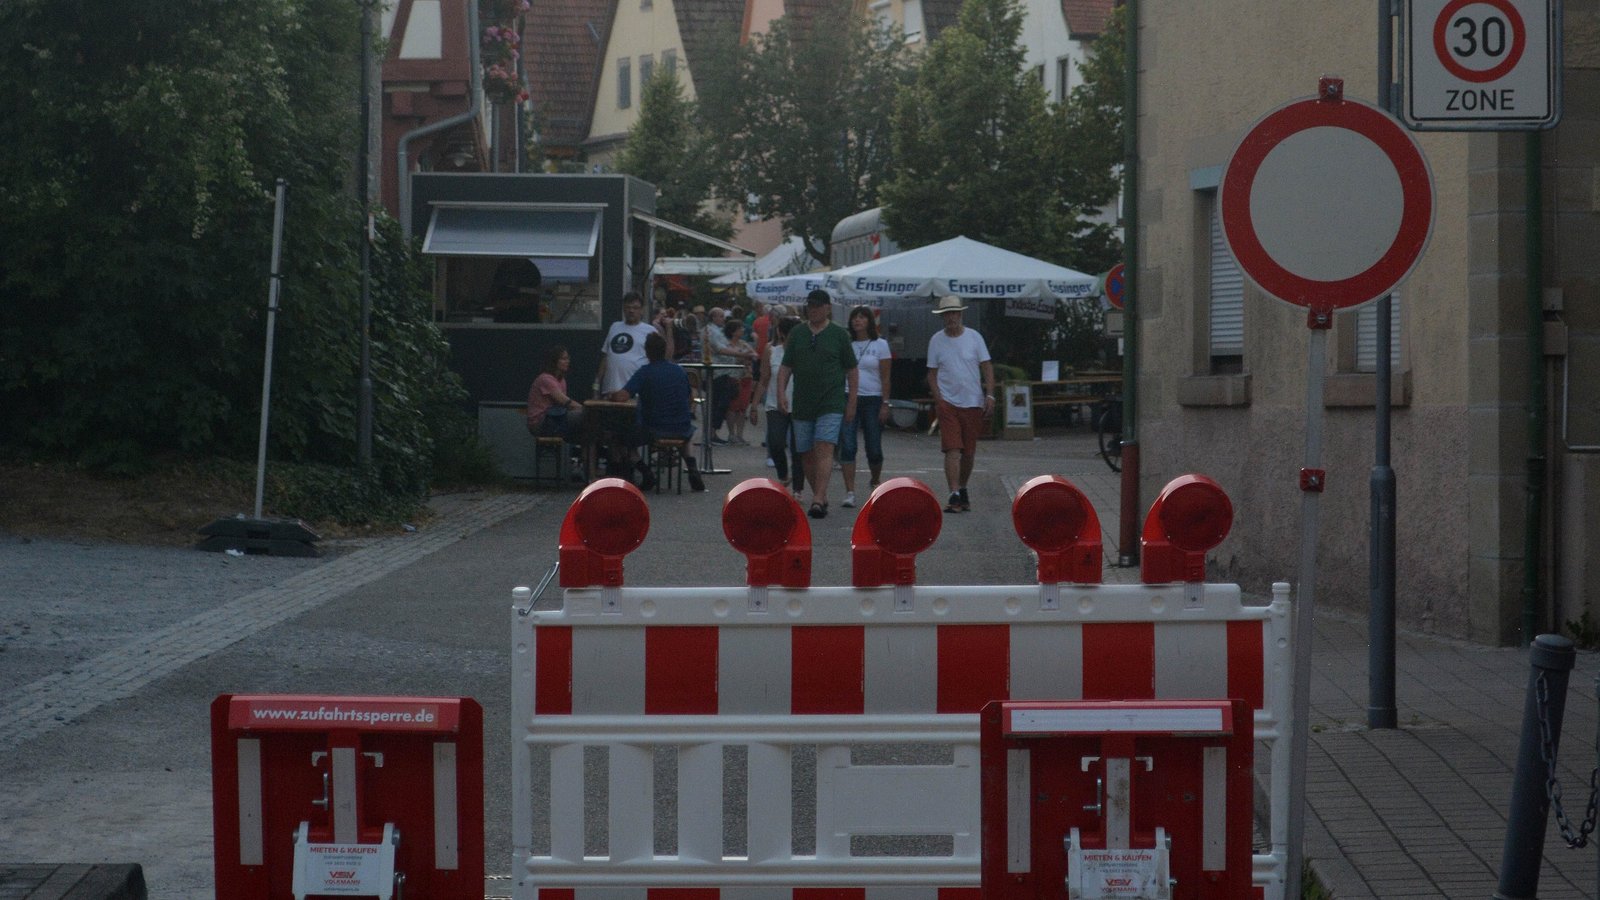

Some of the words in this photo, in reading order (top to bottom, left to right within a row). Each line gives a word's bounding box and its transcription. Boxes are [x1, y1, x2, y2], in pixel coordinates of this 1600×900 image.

[1453, 16, 1506, 57] 30
[1446, 89, 1514, 111] ZONE
[856, 277, 920, 293] Ensinger
[948, 279, 1026, 296] Ensinger
[1048, 279, 1092, 296] Ensinger
[253, 707, 435, 725] www.zufahrtssperre.de
